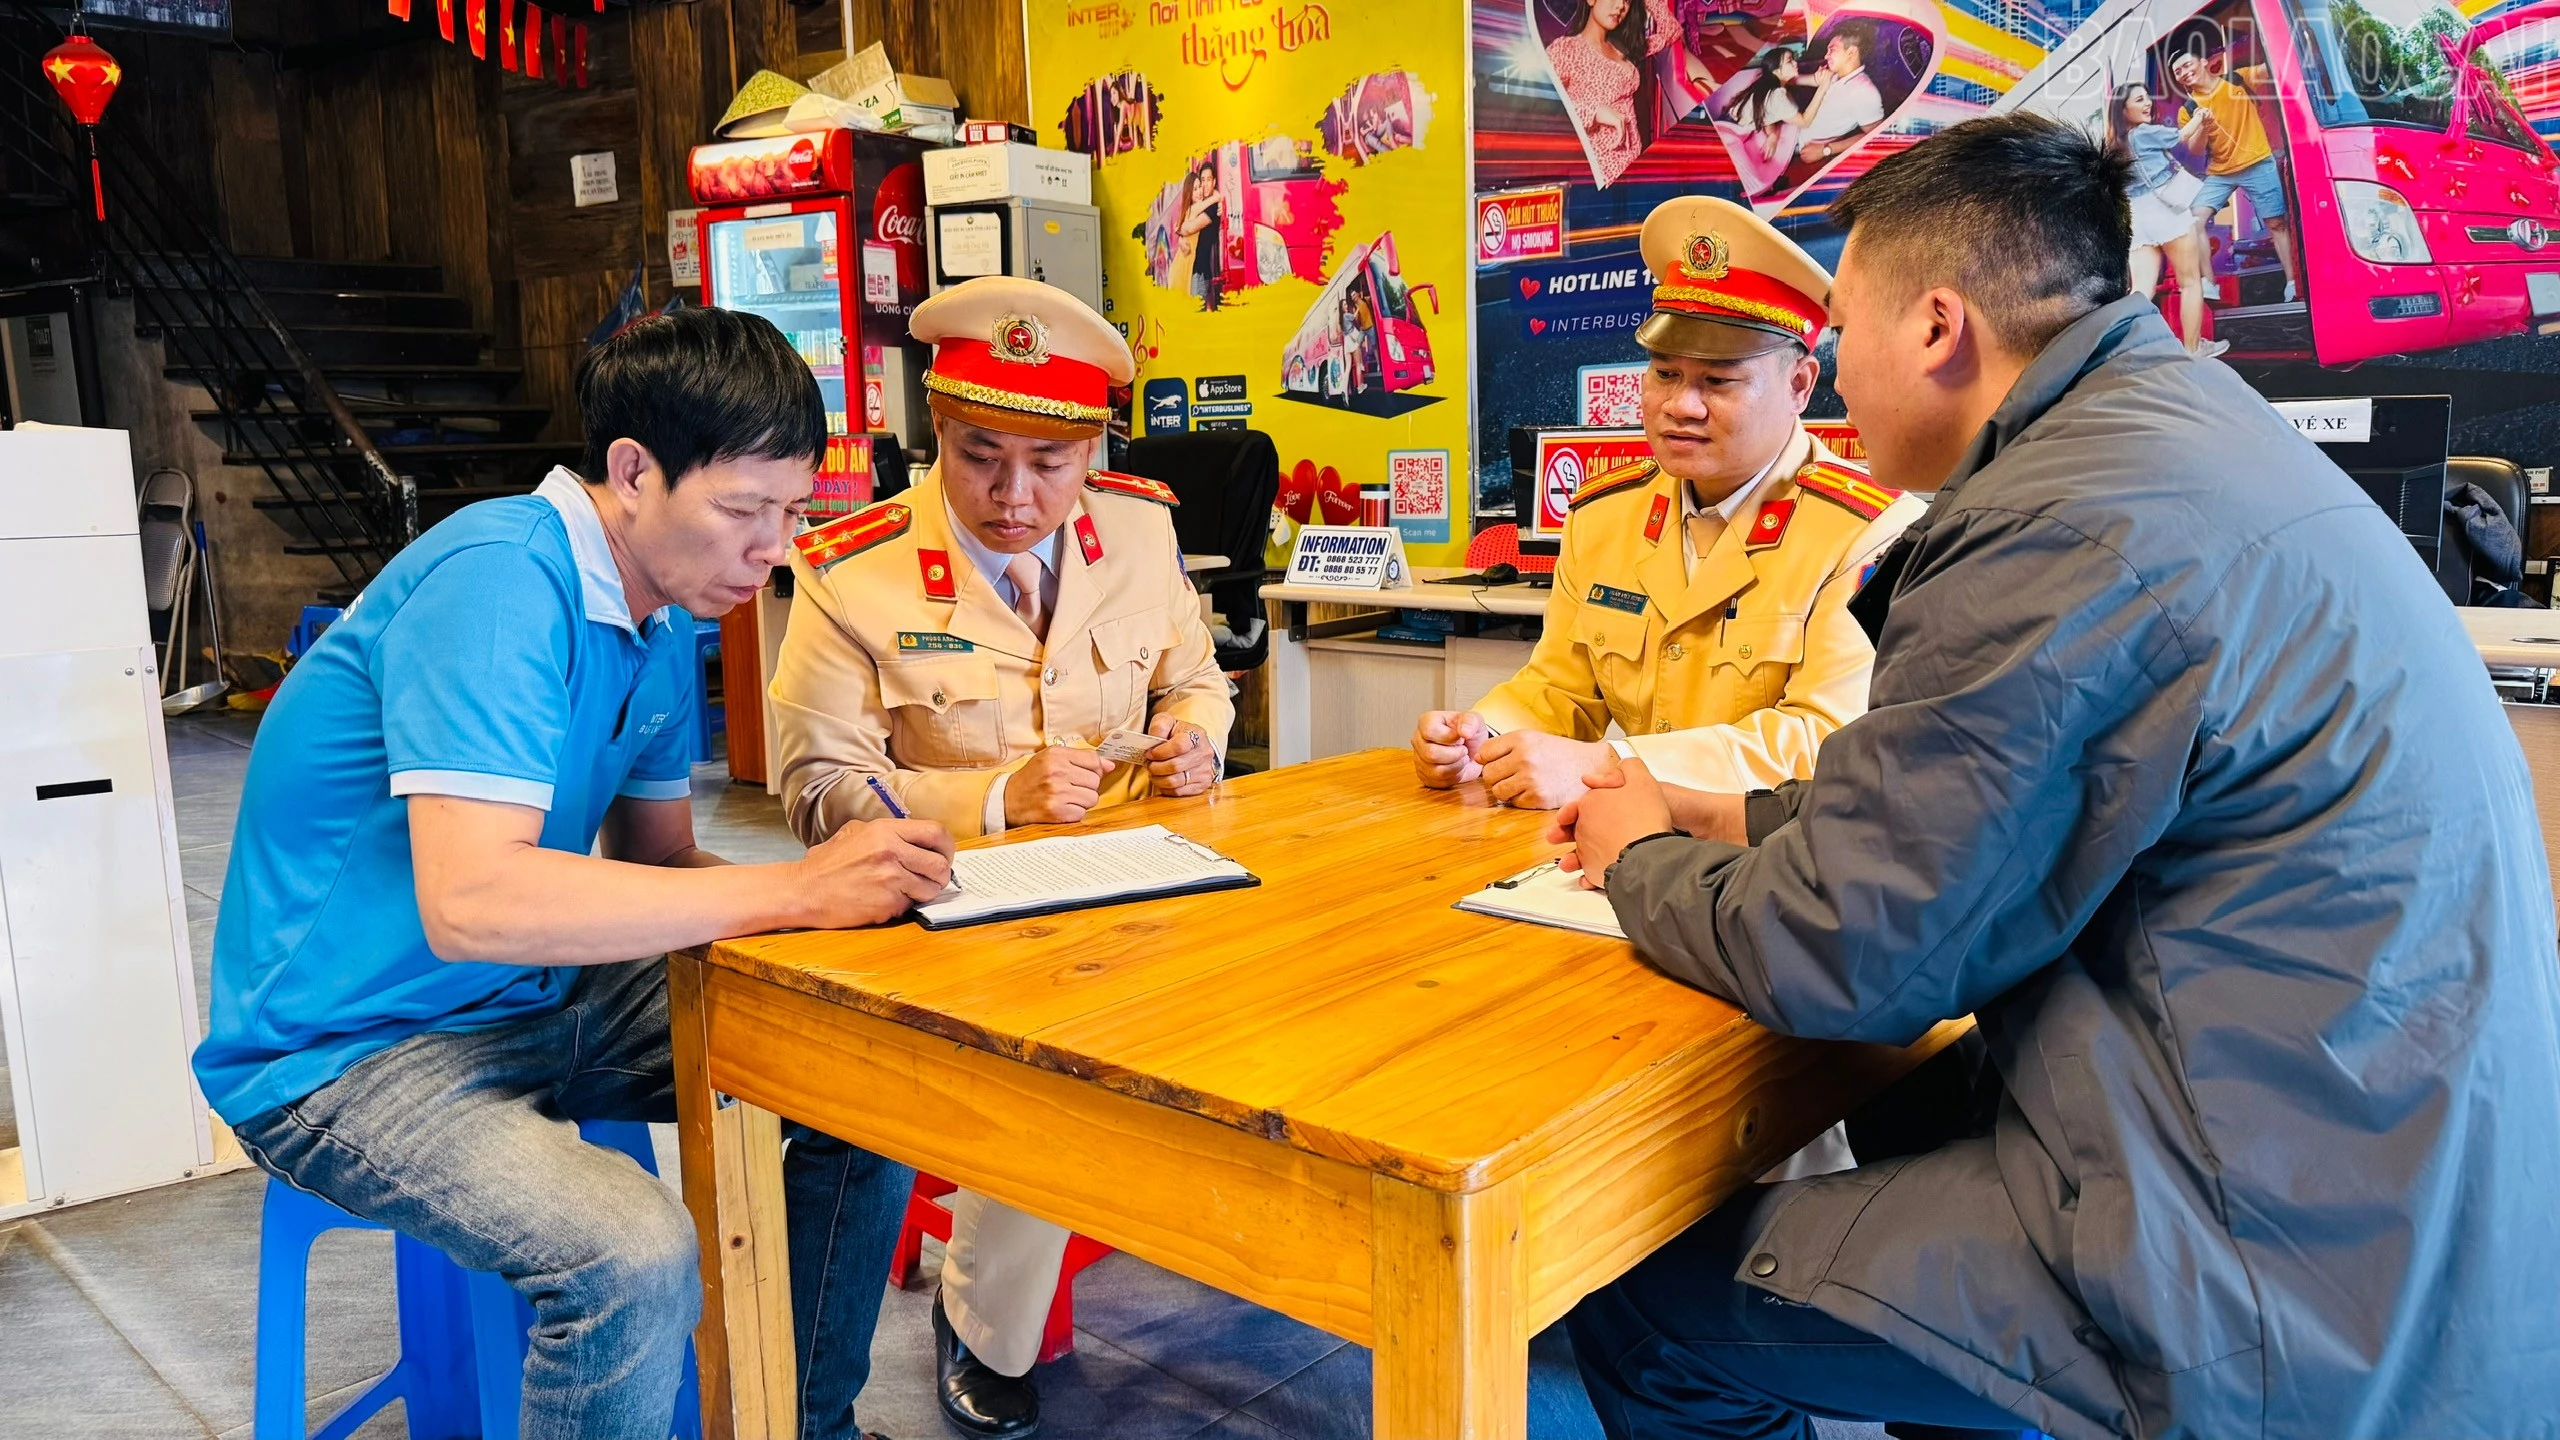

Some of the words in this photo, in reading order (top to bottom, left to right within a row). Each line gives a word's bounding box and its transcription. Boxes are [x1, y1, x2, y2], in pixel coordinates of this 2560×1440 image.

[1068, 3, 1119, 27] INTER
[1507, 200, 1521, 226] CẤM
[1522, 200, 1535, 224] HÚT
[1537, 195, 1558, 222] THUỐC
[1511, 234, 1521, 250] NO
[1522, 231, 1553, 249] SMOKING
[1549, 269, 1638, 294] HOTLINE
[1210, 385, 1224, 396] App
[1224, 383, 1242, 393] Store
[1151, 414, 1181, 427] INTER
[2293, 415, 2317, 430] VÉ
[2323, 418, 2347, 430] XE
[849, 442, 869, 473] ĂN
[1284, 490, 1301, 506] Love
[1324, 490, 1354, 511] Forever
[1403, 528, 1421, 537] Scan
[1424, 529, 1437, 537] me
[1300, 535, 1387, 555] INFORMATION
[1298, 555, 1321, 573] ĐT:
[1348, 556, 1363, 564] 523
[1365, 556, 1380, 565] 777
[1356, 566, 1366, 574] 55
[1368, 566, 1378, 575] 77
[1413, 611, 1451, 623] Double
